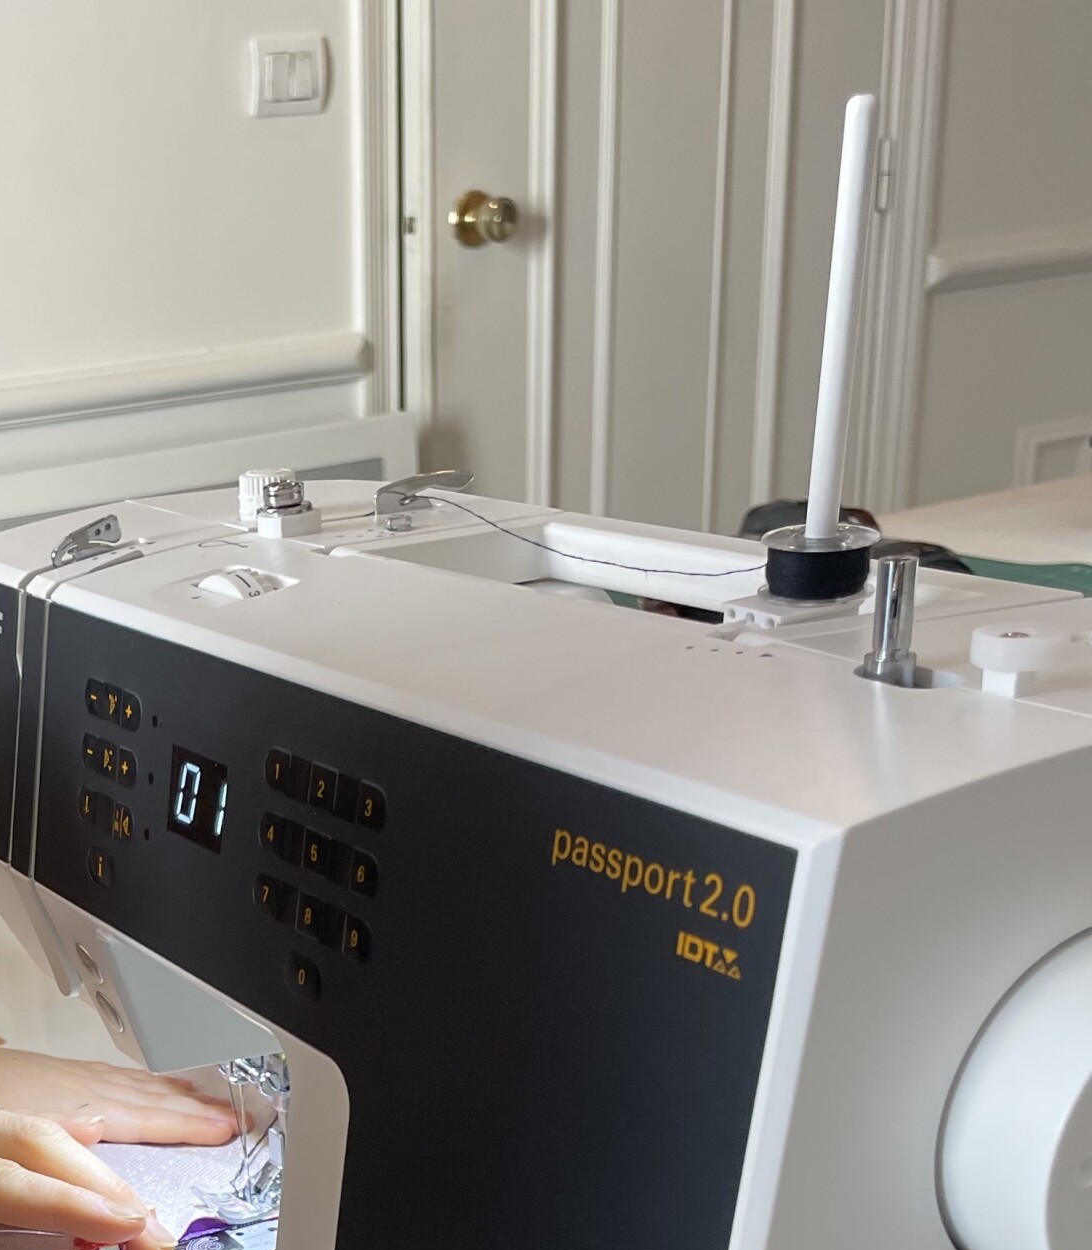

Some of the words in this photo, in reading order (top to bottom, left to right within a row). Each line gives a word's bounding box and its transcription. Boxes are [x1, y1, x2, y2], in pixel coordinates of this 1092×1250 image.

[174, 762, 228, 836] 01
[275, 763, 280, 780] 1
[316, 780, 325, 798] 2
[364, 798, 373, 817] 3
[267, 825, 274, 842] 4
[310, 844, 318, 862] 5
[357, 865, 365, 883] 6
[552, 828, 696, 908] passport
[699, 873, 756, 928] 2.0
[262, 885, 269, 902] 7
[304, 907, 312, 925] 8
[350, 930, 358, 948] 9
[298, 969, 306, 986] 0
[676, 931, 720, 967] IDT
